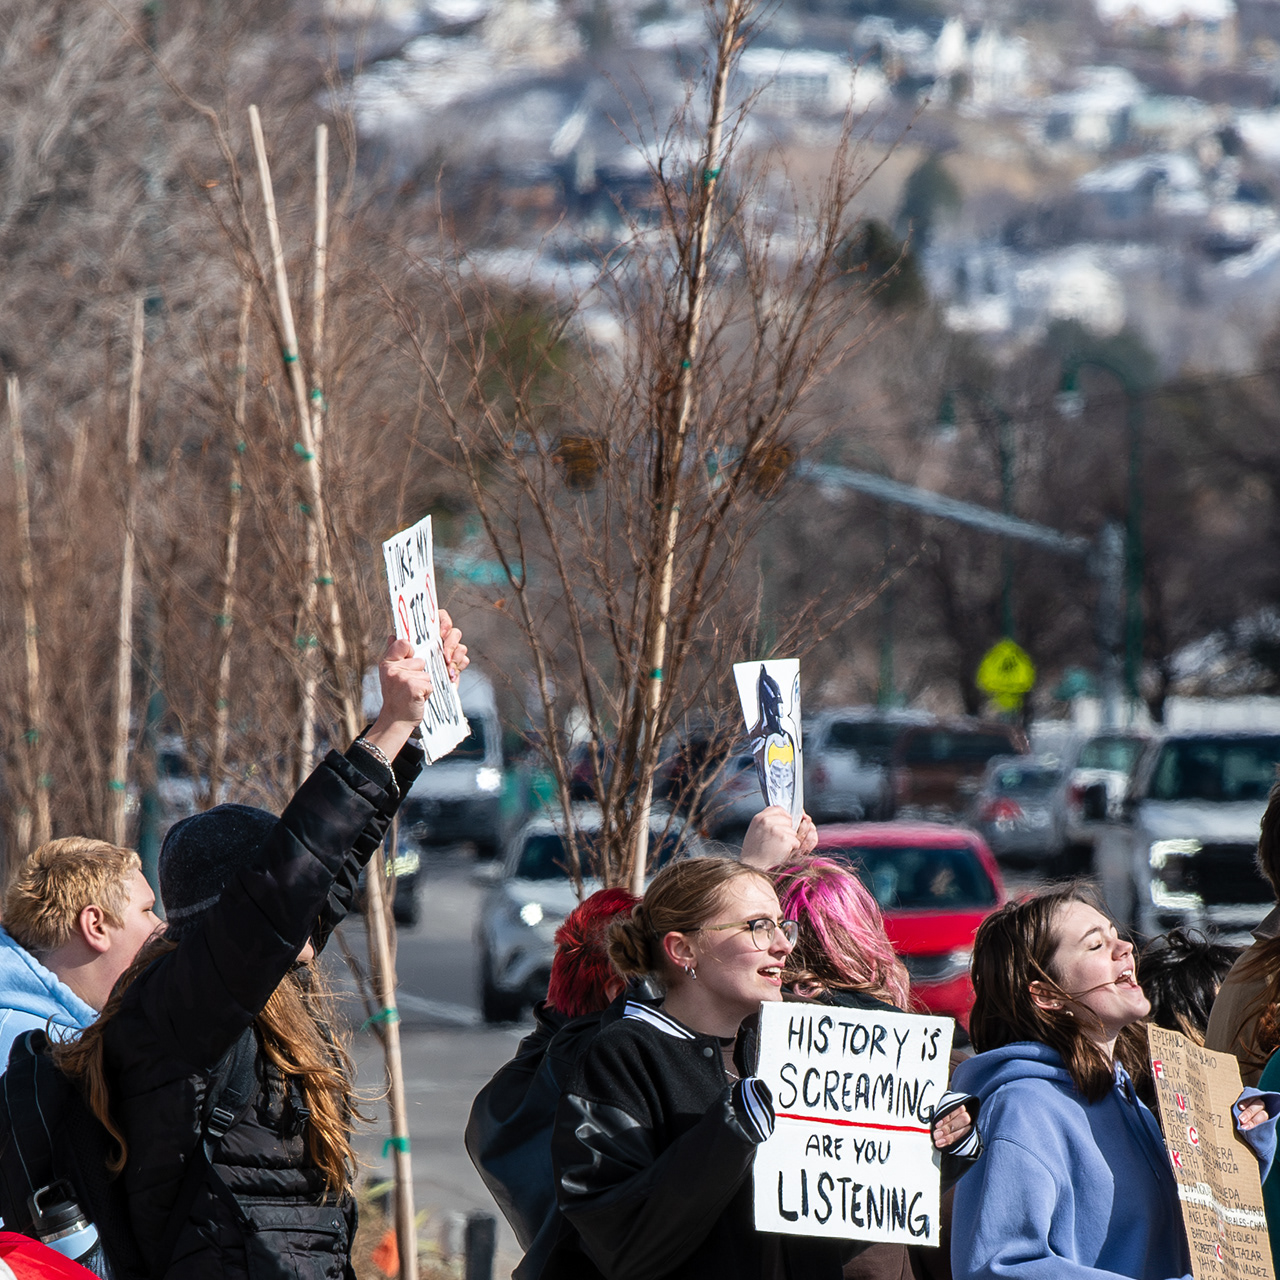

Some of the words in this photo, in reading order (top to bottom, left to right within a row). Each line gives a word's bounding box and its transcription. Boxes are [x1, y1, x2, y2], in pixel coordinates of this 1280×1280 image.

[788, 1014, 911, 1070] HISTORY
[1153, 1060, 1181, 1079] FELIX
[779, 1062, 935, 1124] SCREAMING
[806, 1134, 844, 1161] ARE
[853, 1138, 891, 1165] YOU
[1172, 1150, 1199, 1169] KEITH
[778, 1168, 931, 1239] LISTENING
